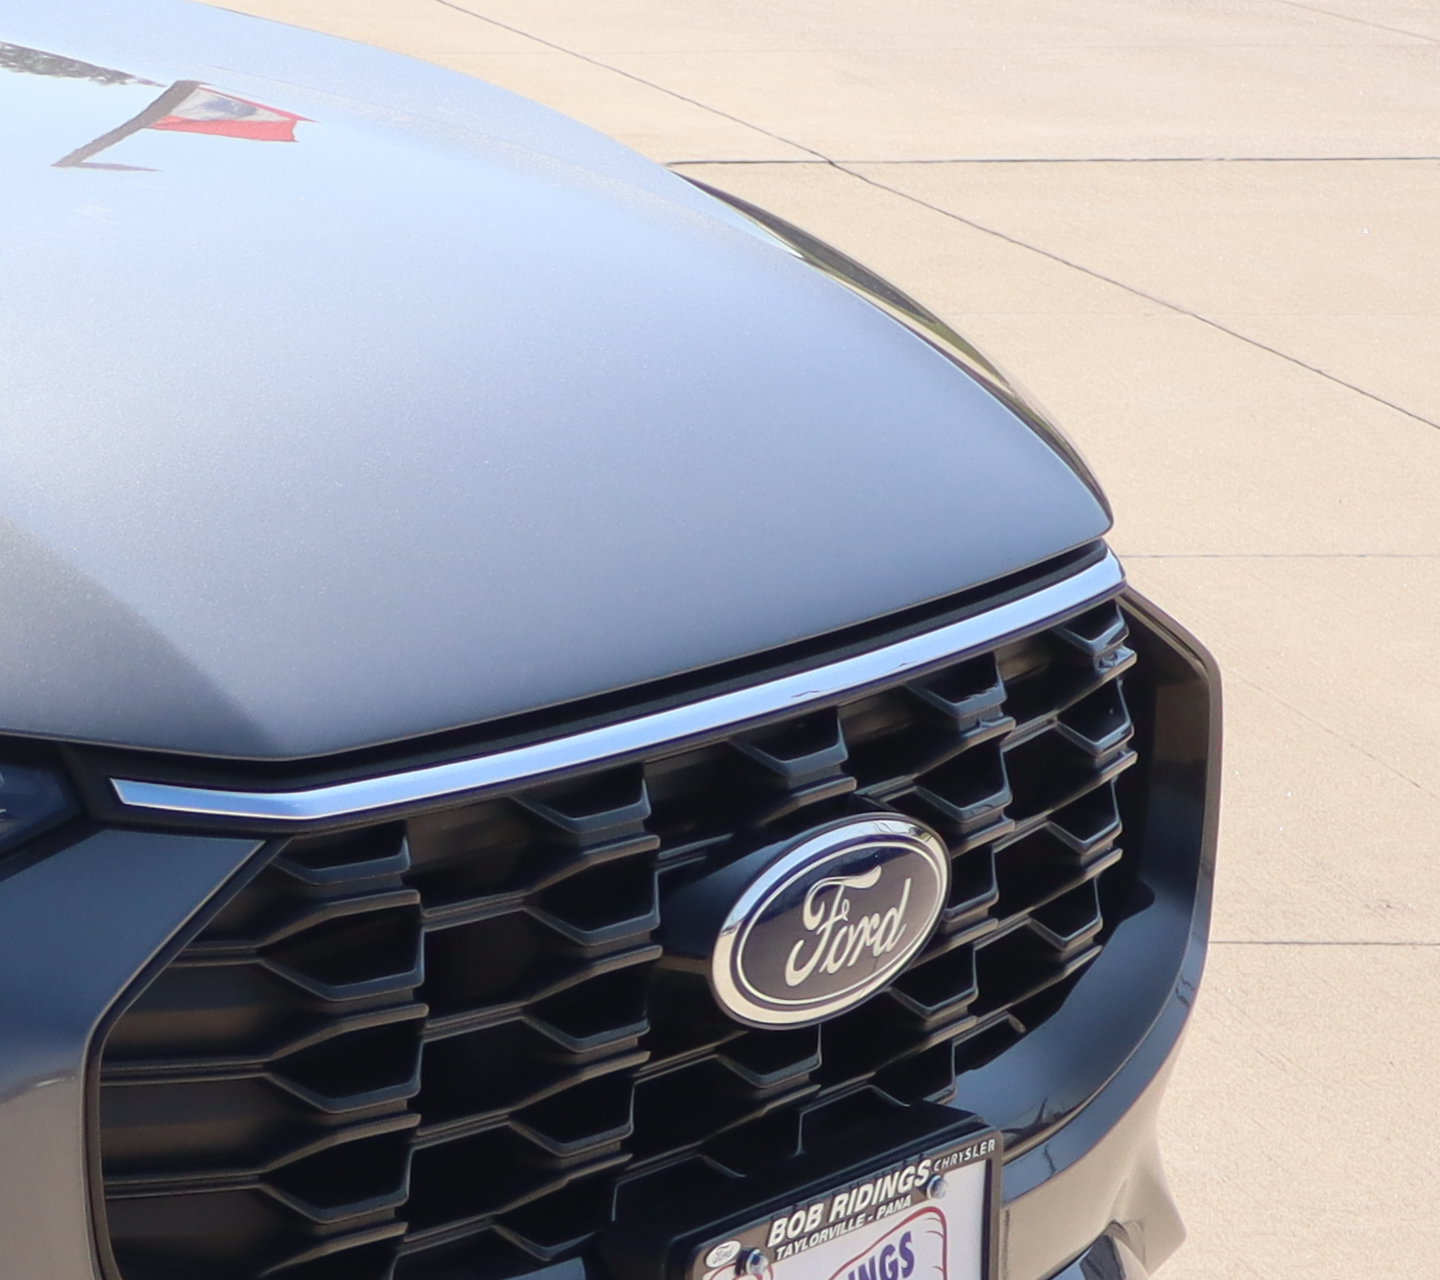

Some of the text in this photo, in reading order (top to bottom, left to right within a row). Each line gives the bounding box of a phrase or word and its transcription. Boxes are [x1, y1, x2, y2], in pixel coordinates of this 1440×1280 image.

[784, 865, 913, 987] Ford
[933, 1138, 996, 1173] CHRYSLER
[767, 1158, 932, 1248] BOB RIDINGS
[775, 1213, 865, 1261] TAYLORVILLE
[877, 1195, 912, 1220] PANA
